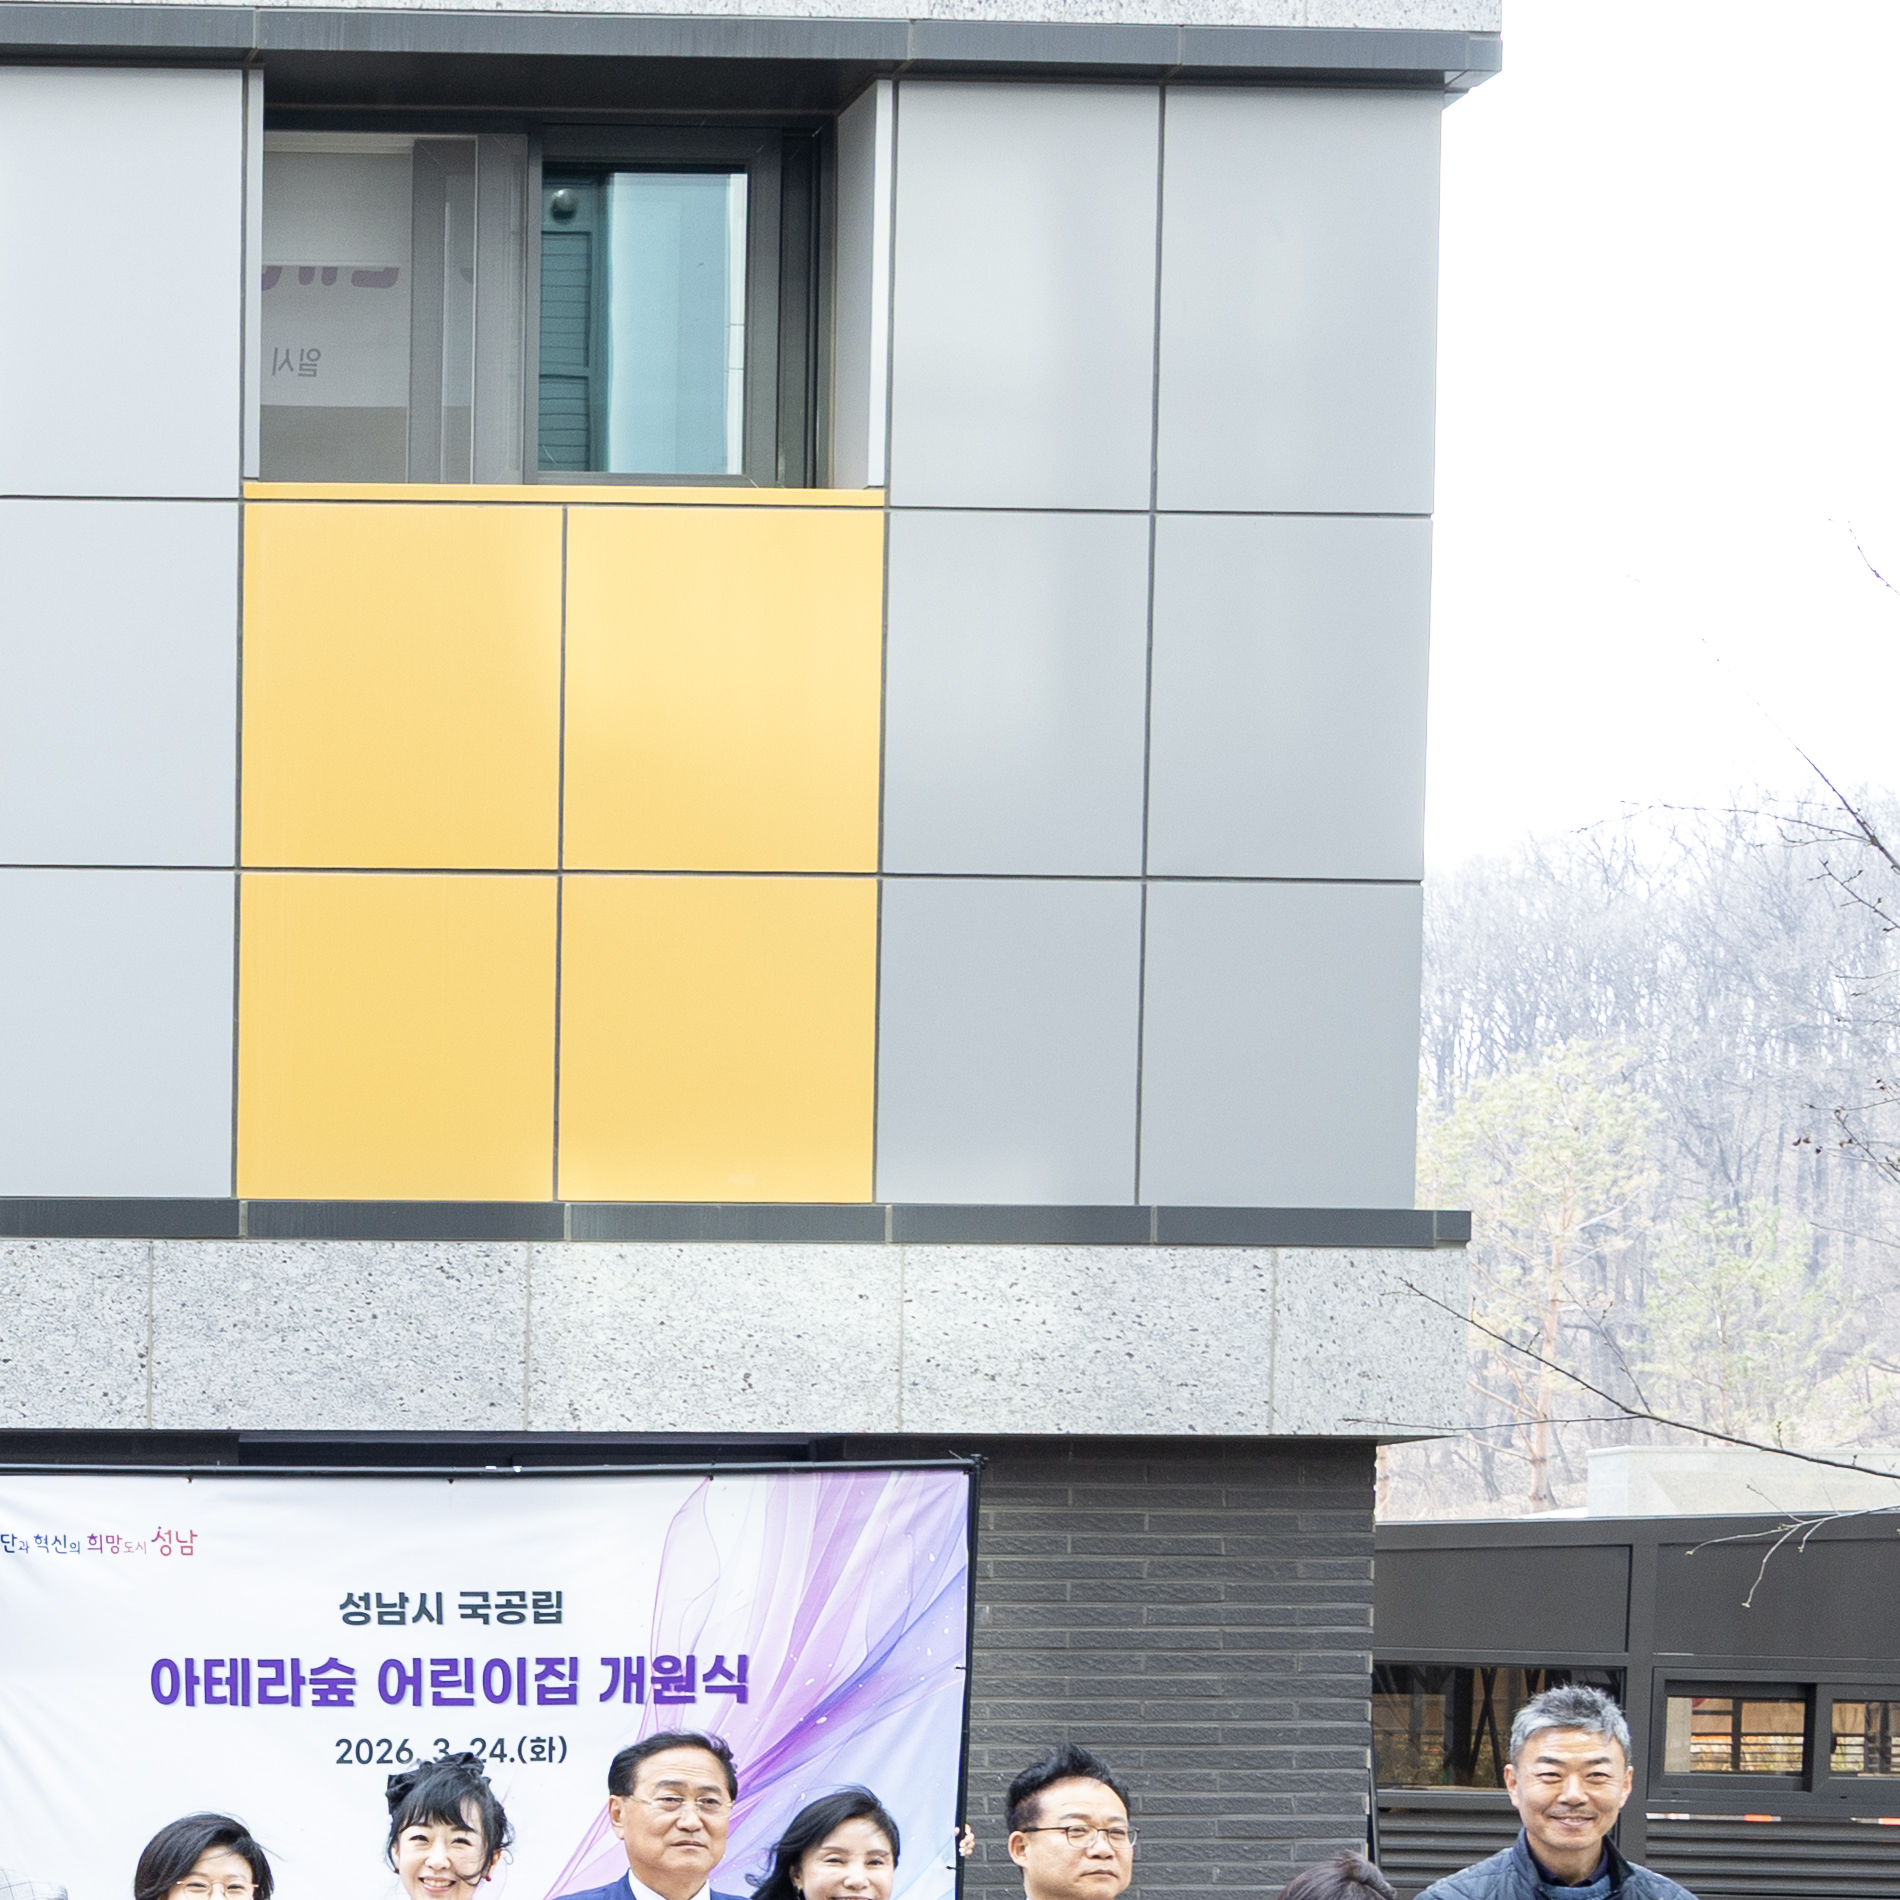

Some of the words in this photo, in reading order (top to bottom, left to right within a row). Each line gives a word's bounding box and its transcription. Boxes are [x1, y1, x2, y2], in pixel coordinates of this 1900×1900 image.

[33, 1533, 81, 1555] 혁신의
[87, 1533, 148, 1555] 희망도시
[151, 1526, 198, 1557] 성남
[339, 1590, 445, 1627] 성남시
[457, 1590, 565, 1627] 국공립
[150, 1654, 356, 1707] 아테라숲
[378, 1654, 582, 1707] 어린이집
[598, 1652, 752, 1706] 개원식
[469, 1735, 568, 1764] 24.(화)
